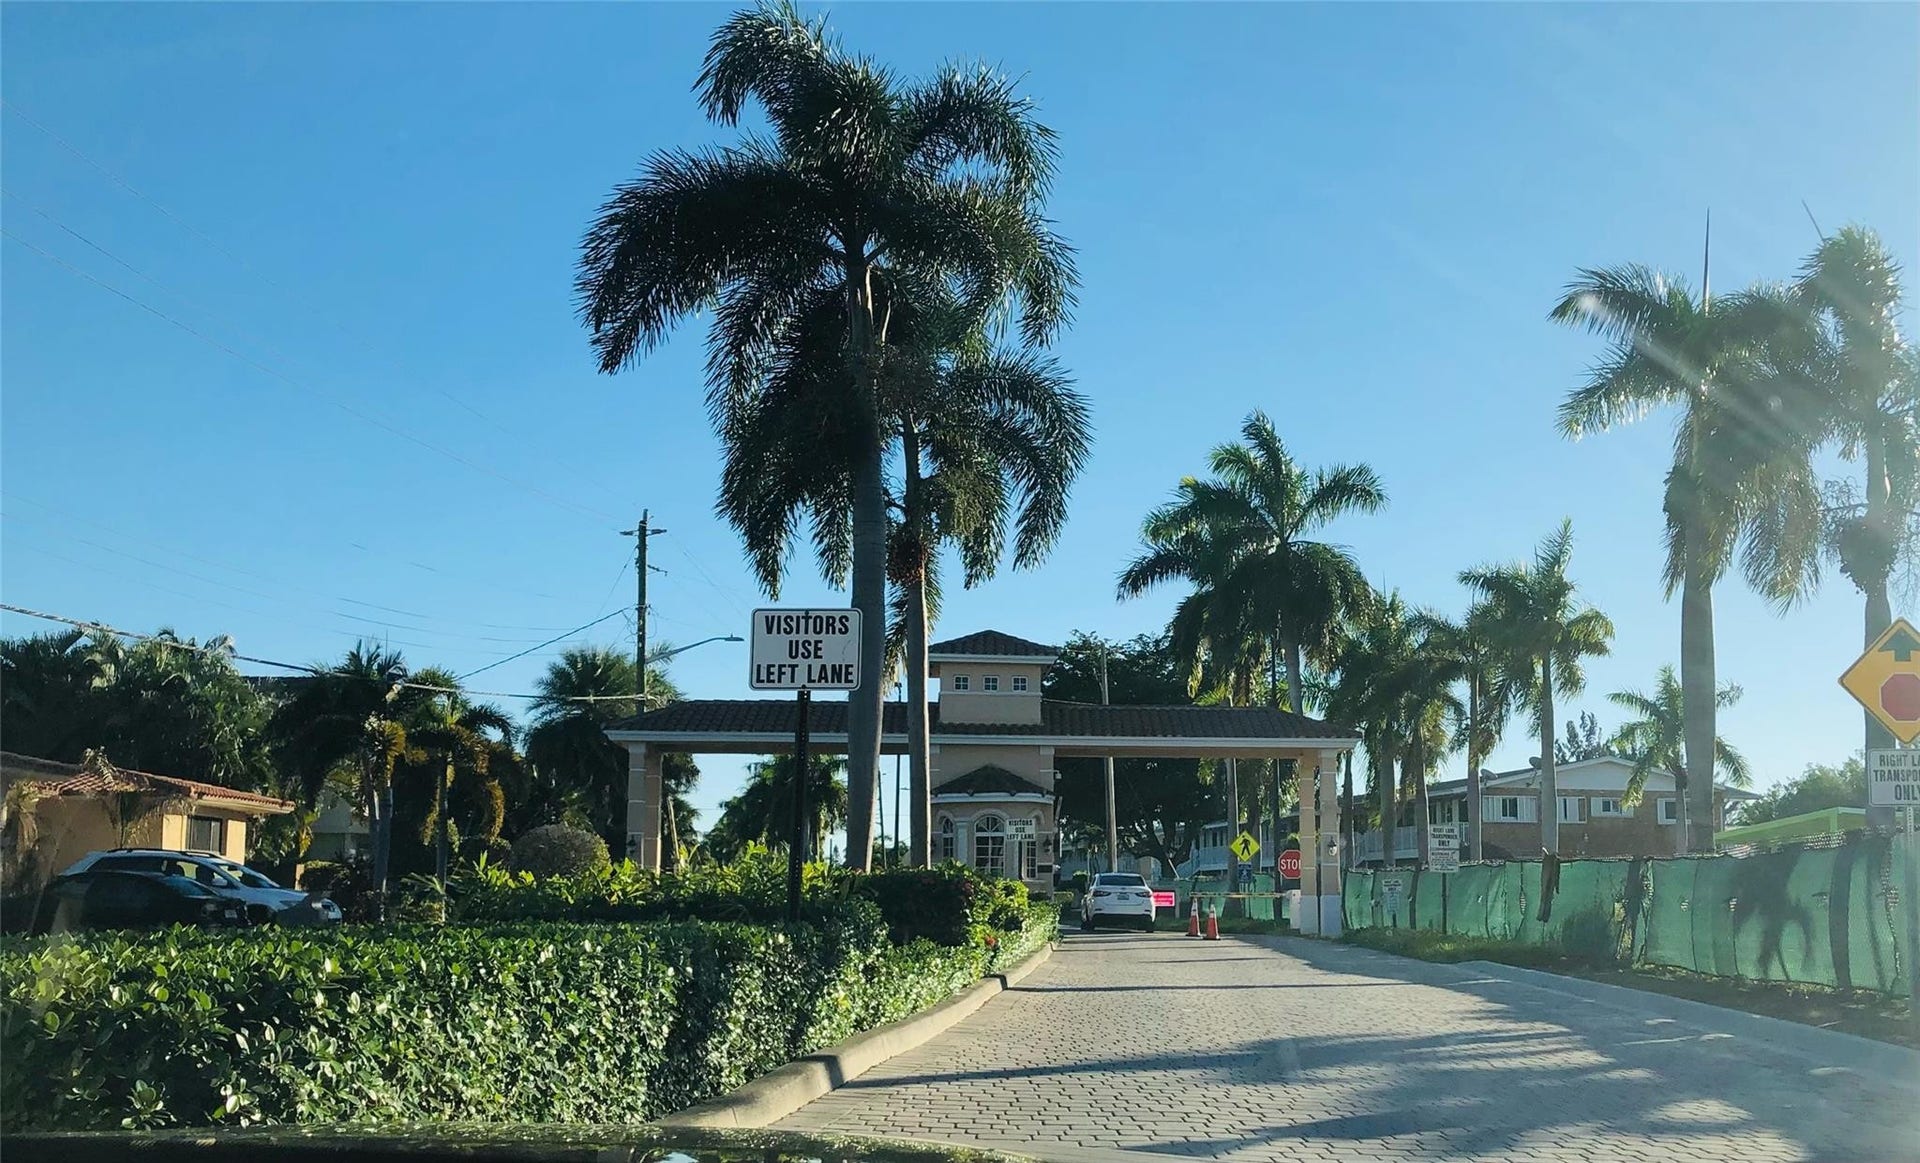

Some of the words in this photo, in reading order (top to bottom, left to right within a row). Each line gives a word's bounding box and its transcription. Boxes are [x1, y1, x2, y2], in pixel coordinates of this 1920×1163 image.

[764, 615, 850, 635] VISITORS
[788, 639, 823, 660] USE
[755, 663, 799, 684] LEFT
[806, 663, 854, 684] LANE
[1879, 754, 1908, 767] RIGHT
[1873, 769, 1920, 782] TRANSPO
[1438, 839, 1450, 847] ONLY
